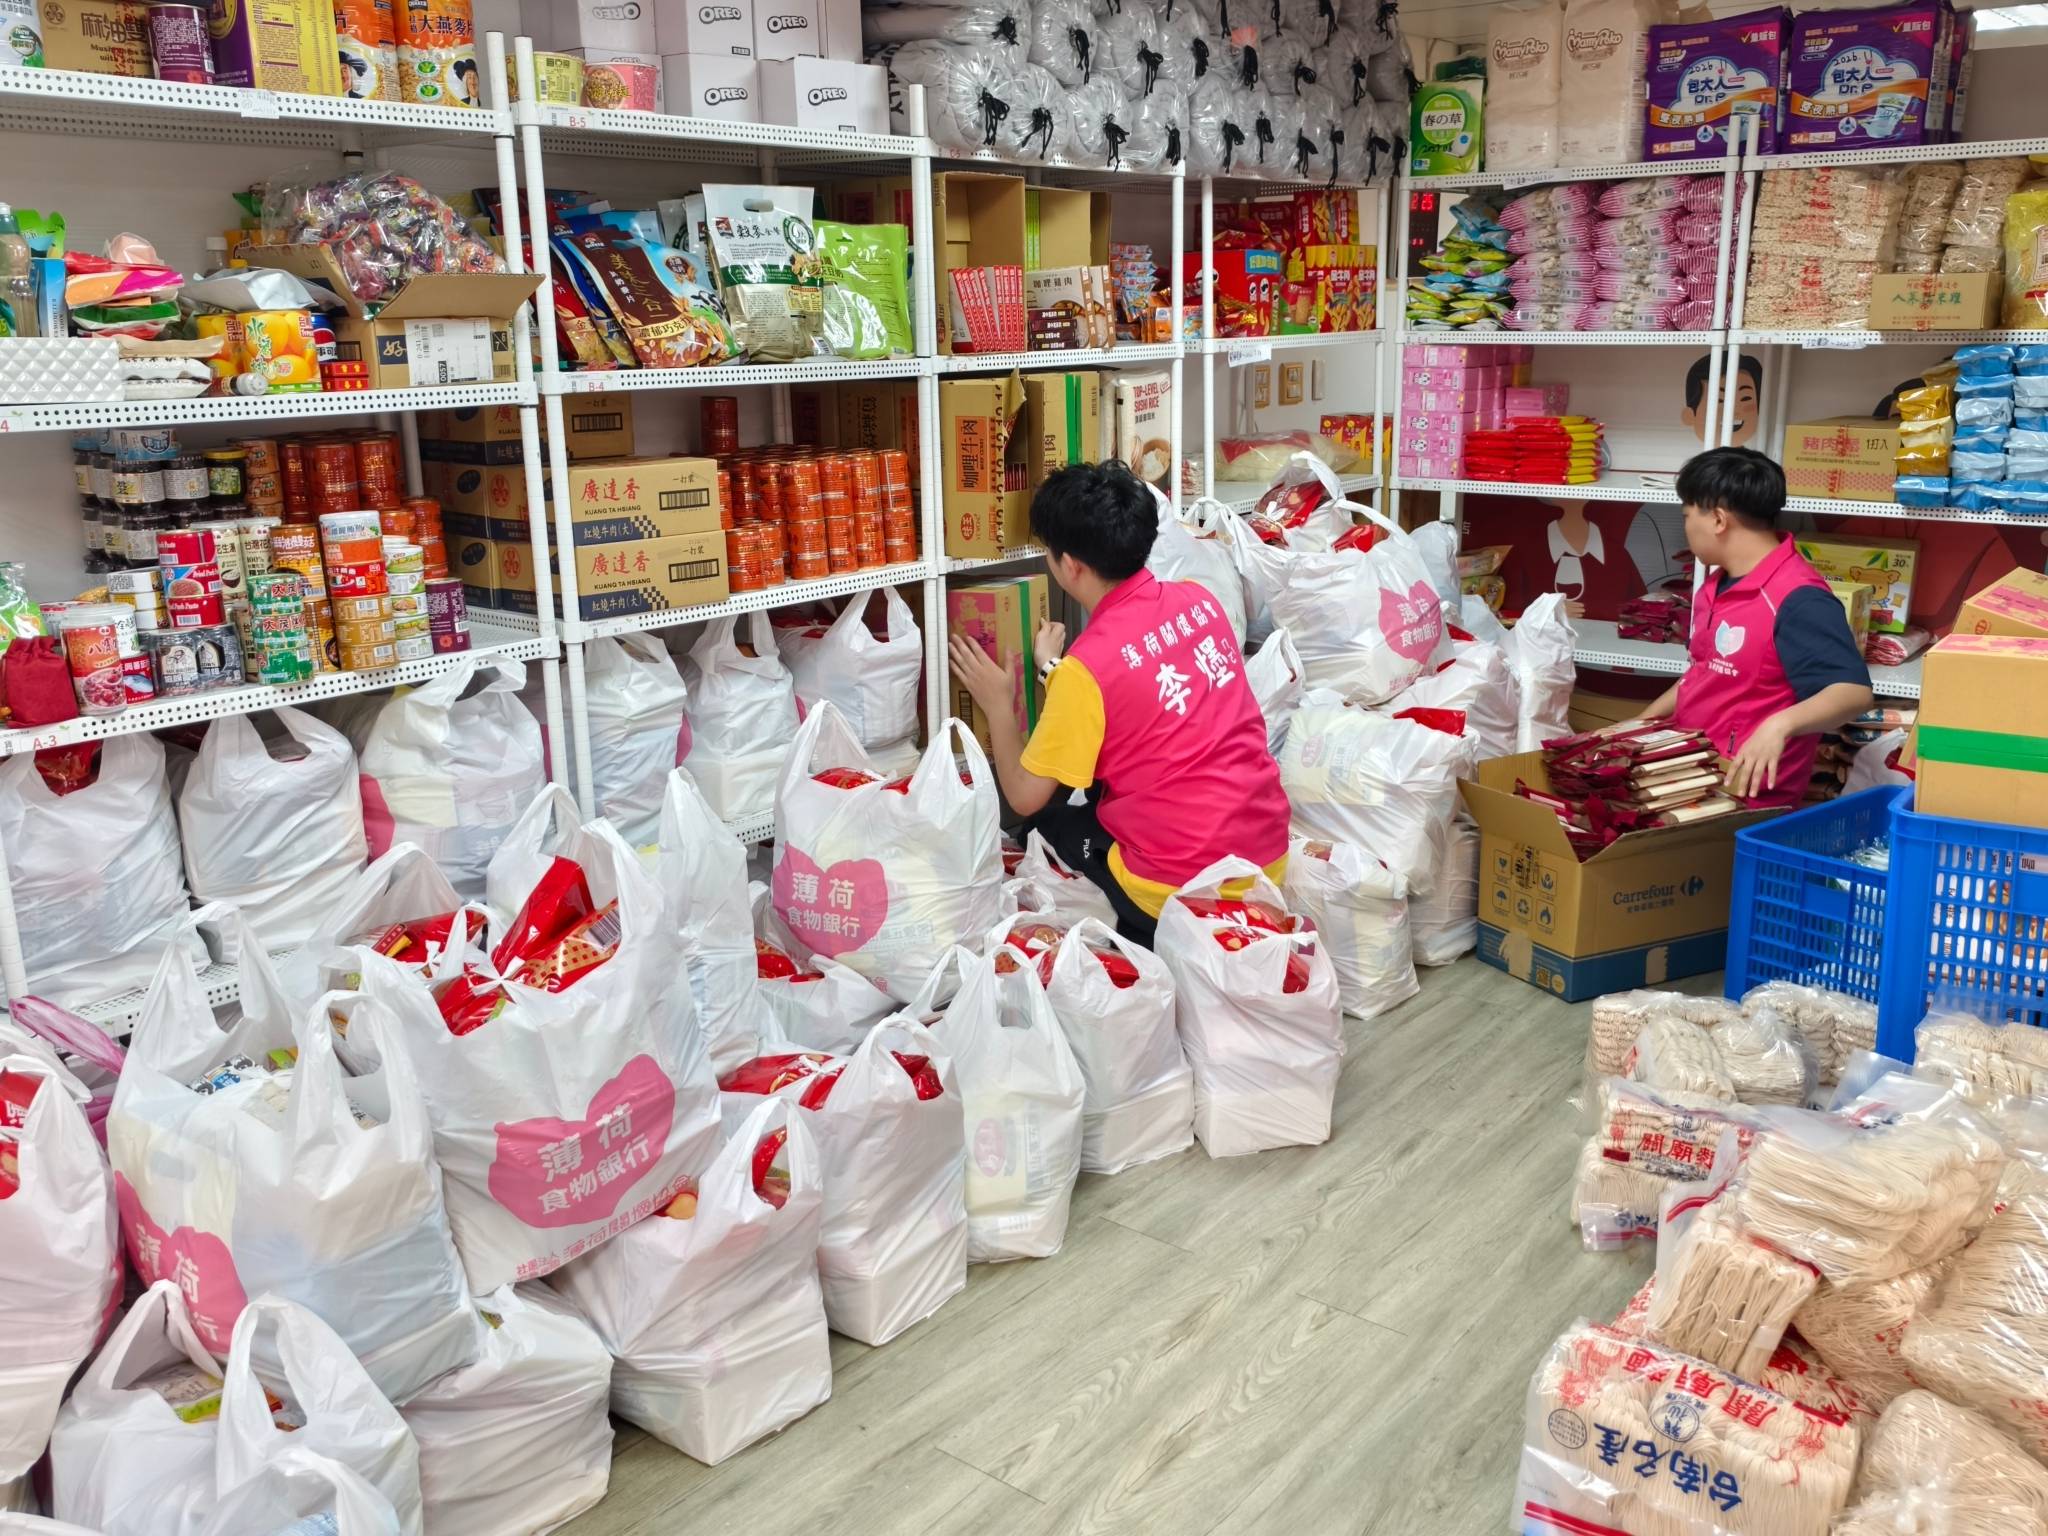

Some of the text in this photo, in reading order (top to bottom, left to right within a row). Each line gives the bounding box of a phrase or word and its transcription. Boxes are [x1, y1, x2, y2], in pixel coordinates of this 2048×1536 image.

[699, 6, 741, 24] OREO
[767, 15, 808, 33] OREO
[1687, 75, 1744, 93] 包大人
[1833, 66, 1893, 83] 包大人
[705, 87, 748, 106] OREO
[808, 87, 847, 106] OREO
[569, 116, 587, 128] B-5
[639, 318, 692, 338] 濃郁巧克力
[1134, 382, 1159, 398] TOP-LEVEL
[581, 477, 640, 503] 廣達香
[585, 507, 607, 516] KUANG
[617, 504, 641, 512] HSIANG
[590, 551, 650, 577] 廣達香
[594, 581, 617, 590] KUANG
[627, 578, 651, 587] HSIANG
[33, 735, 57, 750] A-3
[791, 872, 855, 910] 薄荷
[1613, 884, 1675, 905] Carrefour
[787, 906, 860, 938] 食物銀行
[537, 1102, 633, 1183] 薄荷
[538, 1133, 650, 1215] 食物銀行
[1593, 1423, 1741, 1511] 台南名產
